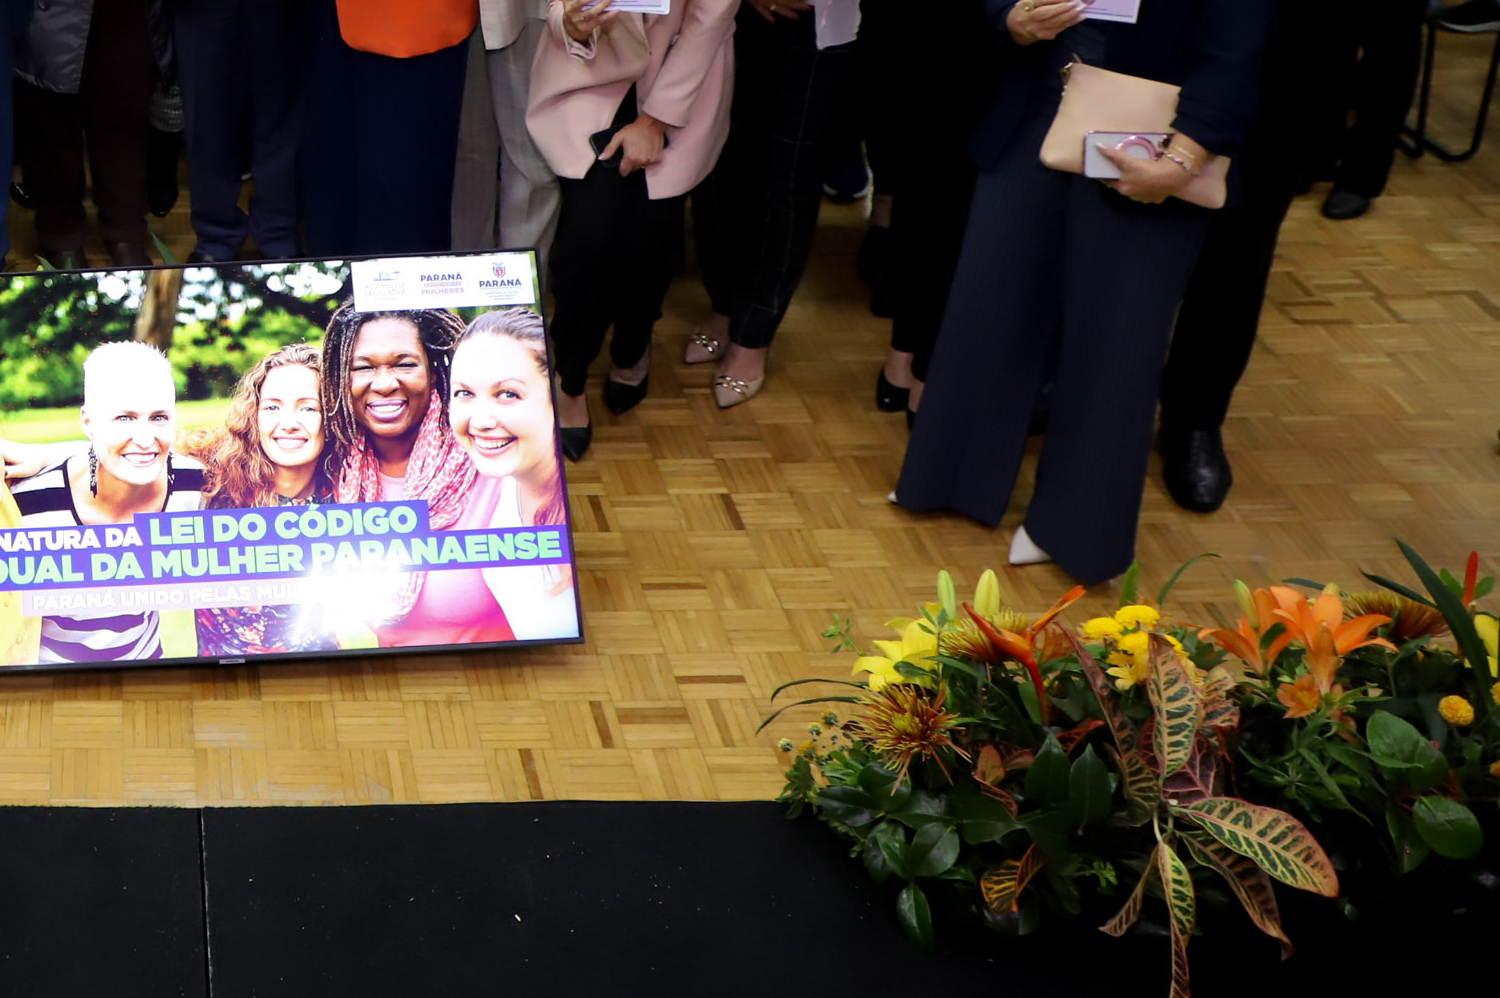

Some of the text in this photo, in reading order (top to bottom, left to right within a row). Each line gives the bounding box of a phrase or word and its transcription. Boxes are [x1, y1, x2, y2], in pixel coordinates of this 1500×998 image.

[420, 272, 462, 282] PARANÁ
[479, 277, 522, 288] PARANÁ
[421, 287, 464, 295] MULHERES
[105, 526, 143, 547] DA
[150, 516, 205, 545] LEI
[212, 514, 266, 543] DO
[275, 504, 417, 538] CÓDIGO
[92, 552, 144, 581] DA
[152, 544, 304, 578] MULHER
[311, 530, 562, 571] PARANAENSE
[33, 589, 114, 610] PARANÁ
[121, 590, 184, 608] UNIDO
[189, 586, 251, 605] PELAS
